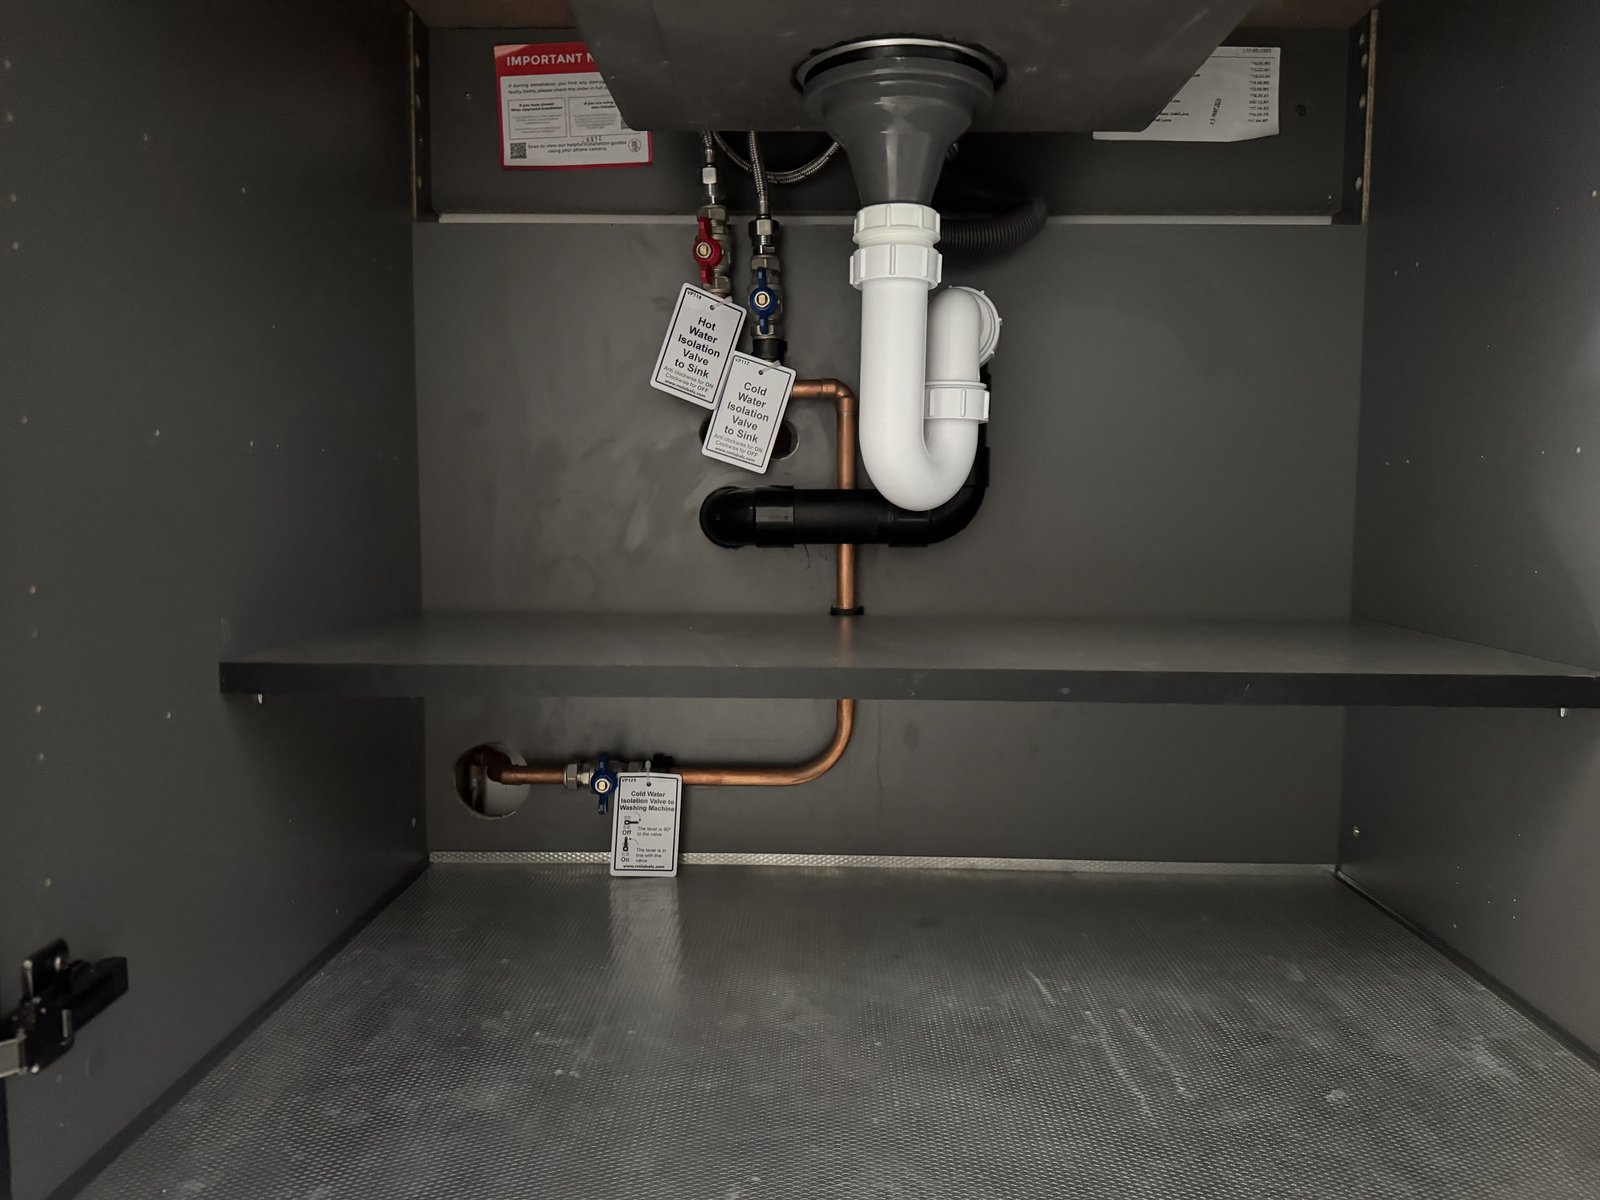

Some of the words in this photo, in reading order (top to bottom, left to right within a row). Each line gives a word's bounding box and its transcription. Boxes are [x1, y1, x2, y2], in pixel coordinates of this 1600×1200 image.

[507, 53, 583, 67] IMPORTANT
[698, 317, 716, 331] Hot
[689, 325, 718, 344] Water
[678, 334, 720, 358] Isolation
[683, 348, 709, 366] Valve
[664, 366, 673, 374] Anti
[674, 369, 698, 382] clockwise
[674, 359, 685, 368] to
[687, 363, 710, 378] Sink
[665, 373, 689, 386] Clockwise
[697, 383, 709, 393] OFF
[744, 382, 767, 396] Cold
[738, 392, 766, 408] Water
[727, 402, 769, 422] Isolation
[732, 415, 758, 430] Valve
[724, 426, 734, 435] to
[737, 429, 759, 443] Sink
[724, 436, 747, 447] clockwise
[715, 440, 739, 452] Clockwise
[747, 449, 758, 457] OFF
